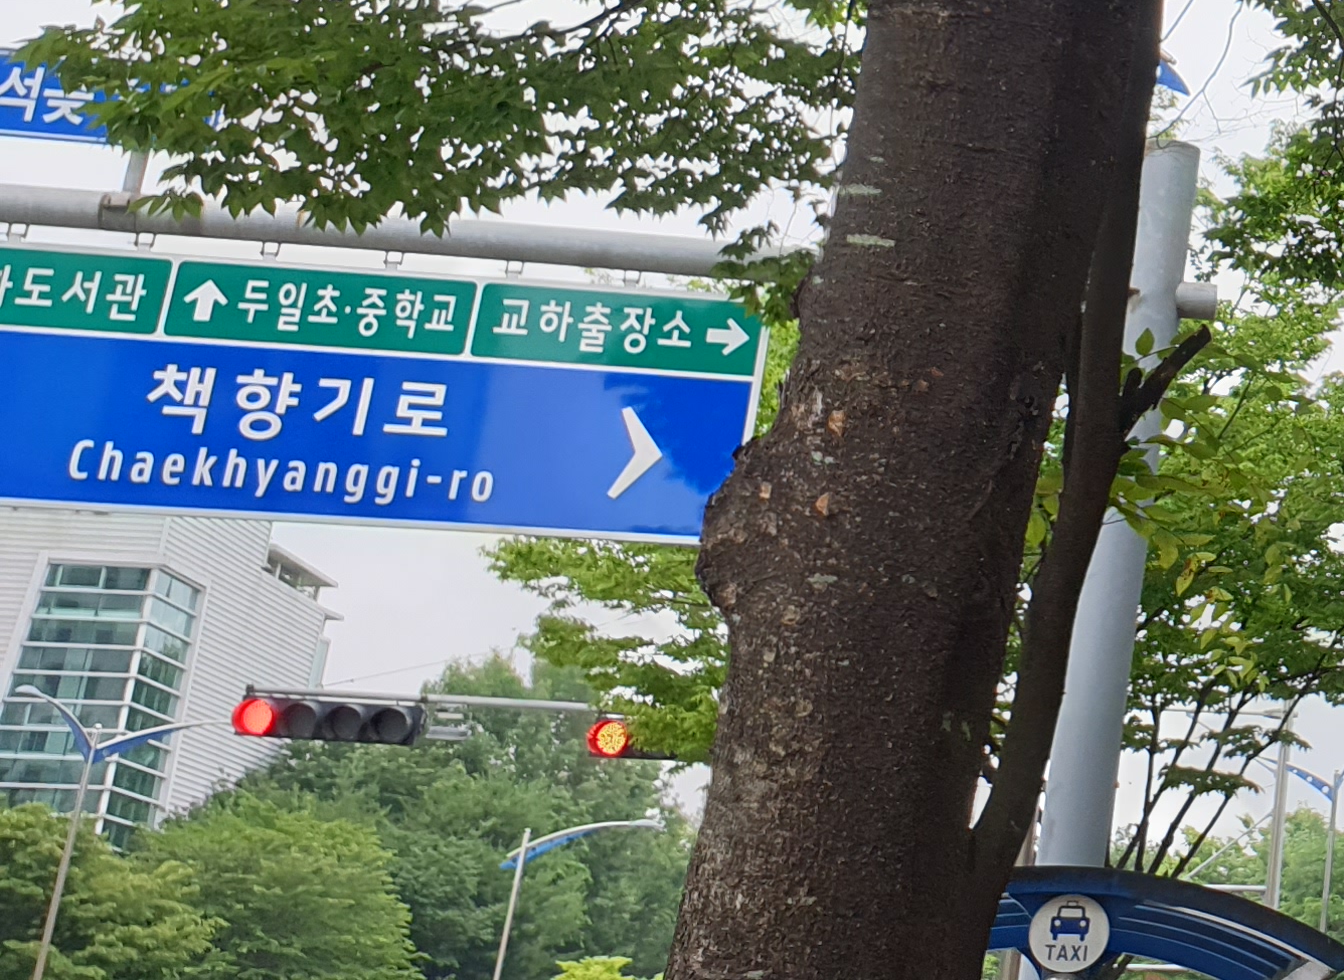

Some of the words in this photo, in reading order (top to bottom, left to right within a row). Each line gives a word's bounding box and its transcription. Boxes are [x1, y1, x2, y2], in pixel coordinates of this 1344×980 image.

[237, 279, 457, 340] 두일초·중학교
[492, 298, 692, 355] 교하출장소
[146, 363, 449, 441] 책향기로
[67, 438, 496, 506] Chaekhyanggi-ro
[1044, 943, 1089, 963] TAXI
